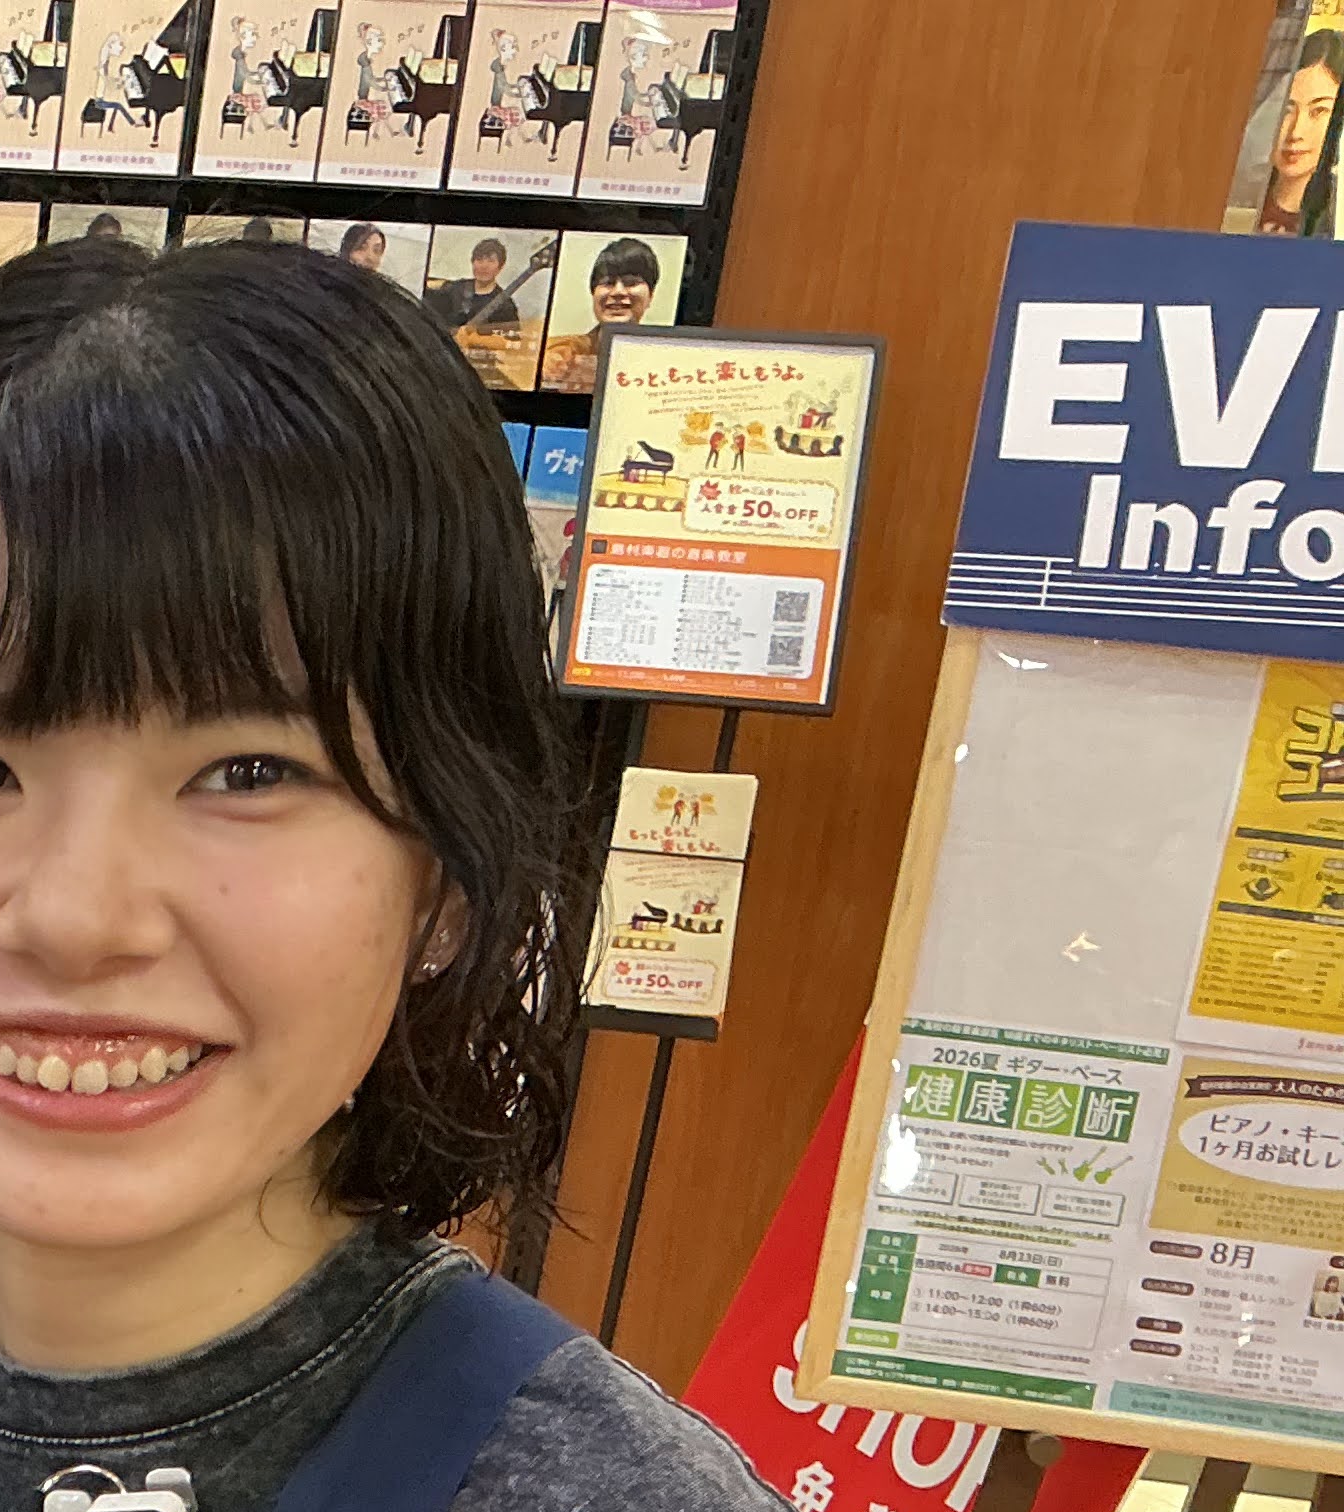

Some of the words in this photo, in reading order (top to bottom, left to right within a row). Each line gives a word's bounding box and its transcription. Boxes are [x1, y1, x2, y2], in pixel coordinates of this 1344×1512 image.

[544, 447, 584, 476] ヴォ
[784, 508, 819, 522] OFF
[677, 980, 703, 989] OFF
[933, 1047, 1001, 1072] 2026夏
[1007, 1055, 1123, 1085] ギター・ベース
[912, 1070, 1133, 1138] 健康診断
[1210, 1114, 1344, 1146] ピアノ・キー
[1210, 1242, 1255, 1269] 8月
